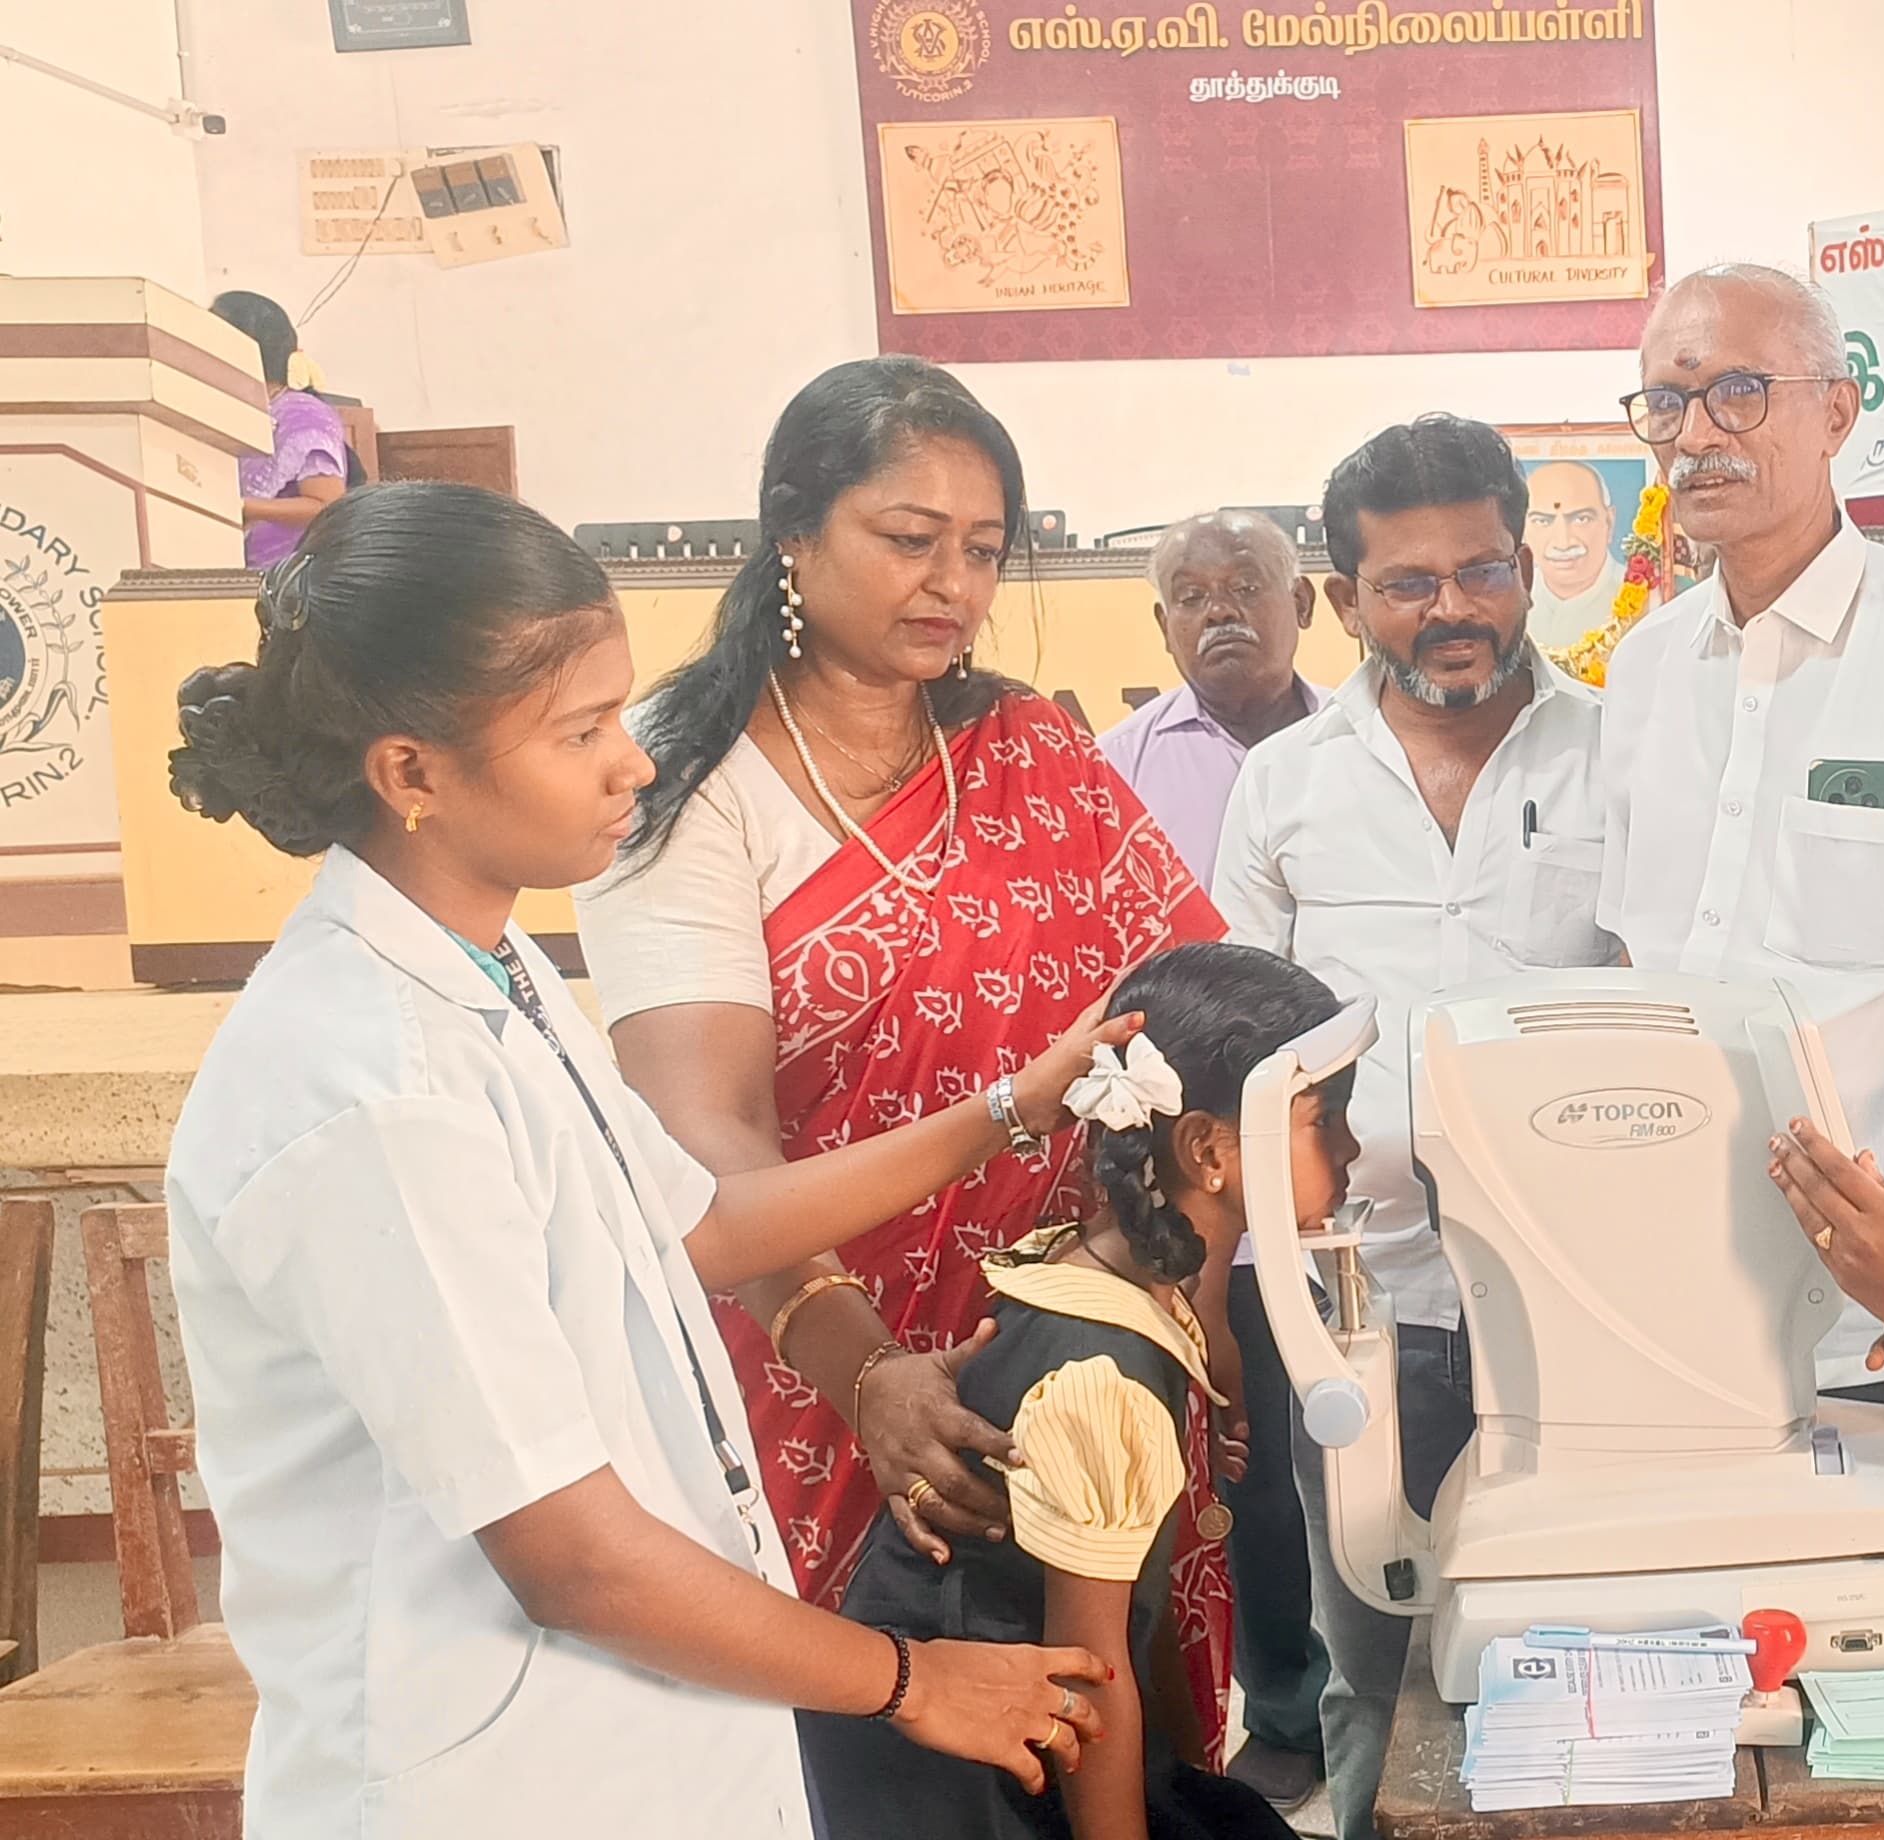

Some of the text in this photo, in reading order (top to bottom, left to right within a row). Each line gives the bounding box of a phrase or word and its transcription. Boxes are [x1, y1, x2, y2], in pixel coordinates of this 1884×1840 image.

[1008, 3, 1229, 57] எஸ்.ஏ.வி.
[1242, 0, 1643, 55] மேல்நிலைப்பள்ளி
[1190, 69, 1341, 102] தூத்துக்குடி
[995, 279, 1106, 298] INDIAN HERITAGE
[1488, 266, 1628, 285] CULTURAL DIVERSITY
[0, 506, 90, 576] DARY
[0, 588, 38, 639] OWER
[0, 747, 84, 808] RIN.2
[505, 959, 535, 1003] THE
[1592, 1102, 1683, 1122] TOPCON
[1656, 1125, 1676, 1136] 800
